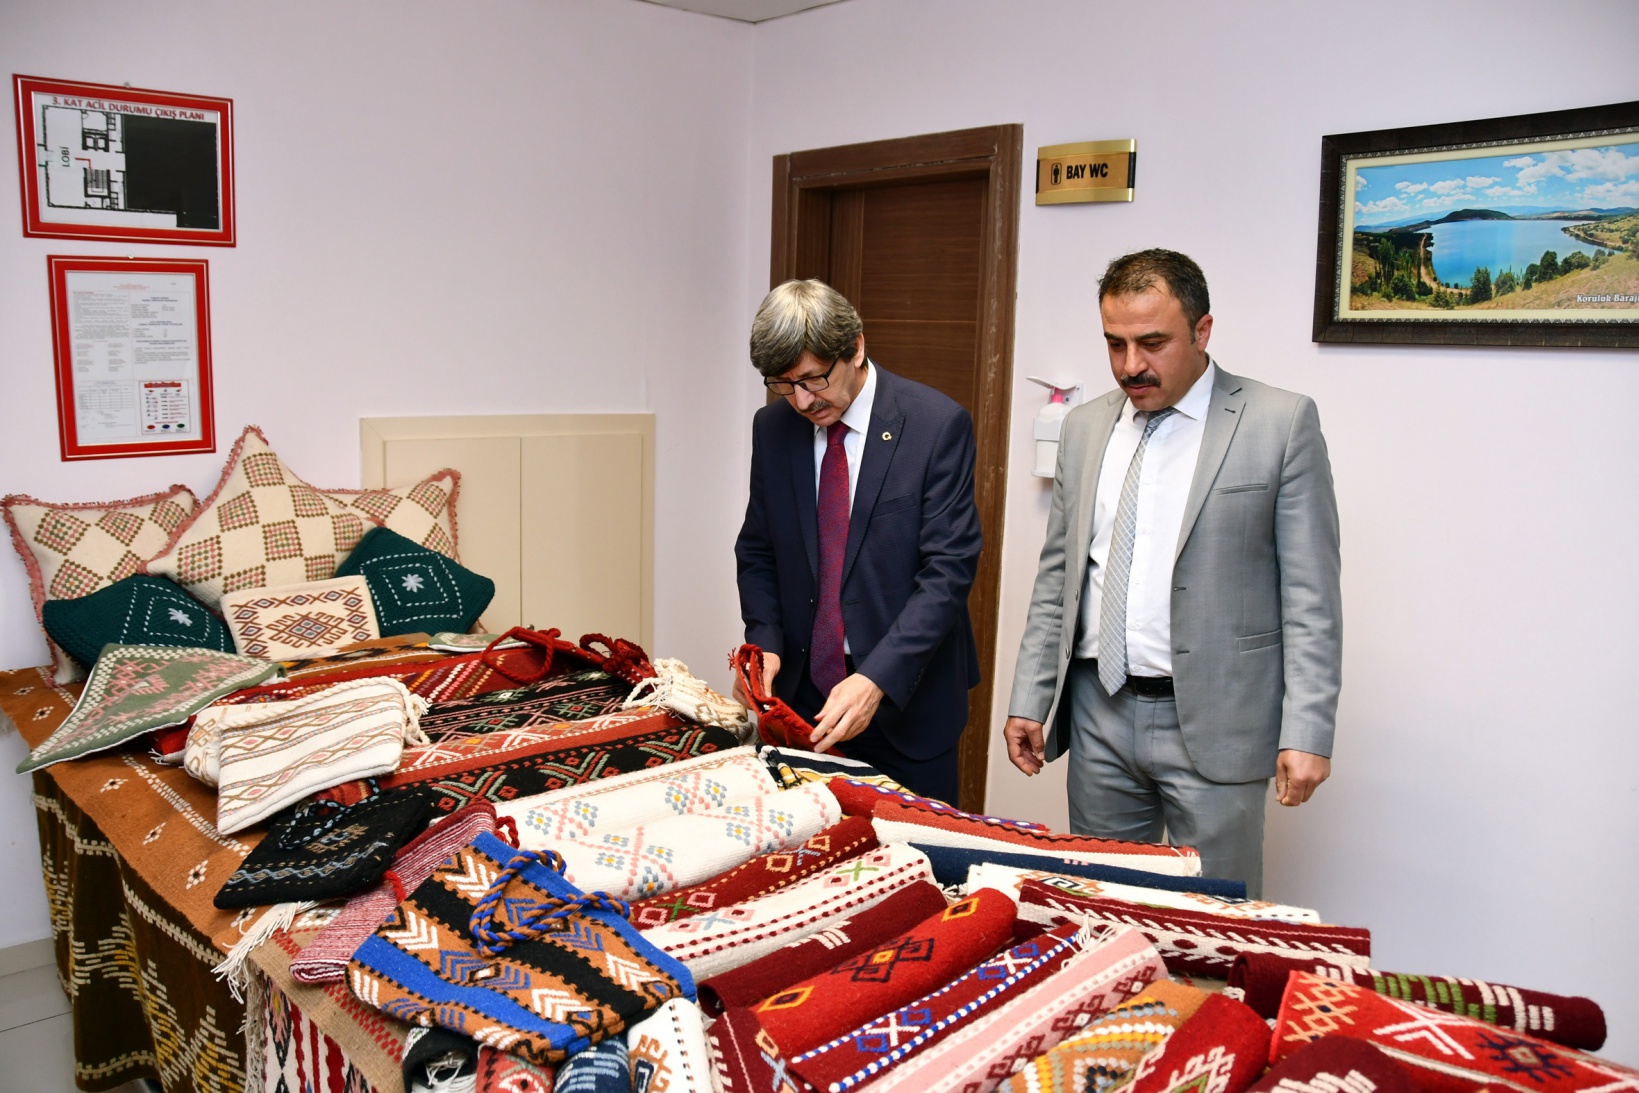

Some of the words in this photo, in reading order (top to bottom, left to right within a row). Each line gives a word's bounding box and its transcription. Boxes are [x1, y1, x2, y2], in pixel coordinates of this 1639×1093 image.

[52, 97, 61, 105] 3.
[64, 98, 83, 107] KAT
[86, 100, 106, 110] ACİL
[108, 103, 152, 115] DURUMU
[155, 108, 177, 120] ÇIKIŞ
[179, 111, 205, 120] PLANI
[60, 146, 70, 167] LOBİ
[1066, 164, 1087, 179] BAY
[1089, 163, 1109, 178] WC
[1576, 294, 1611, 303] Koruluk
